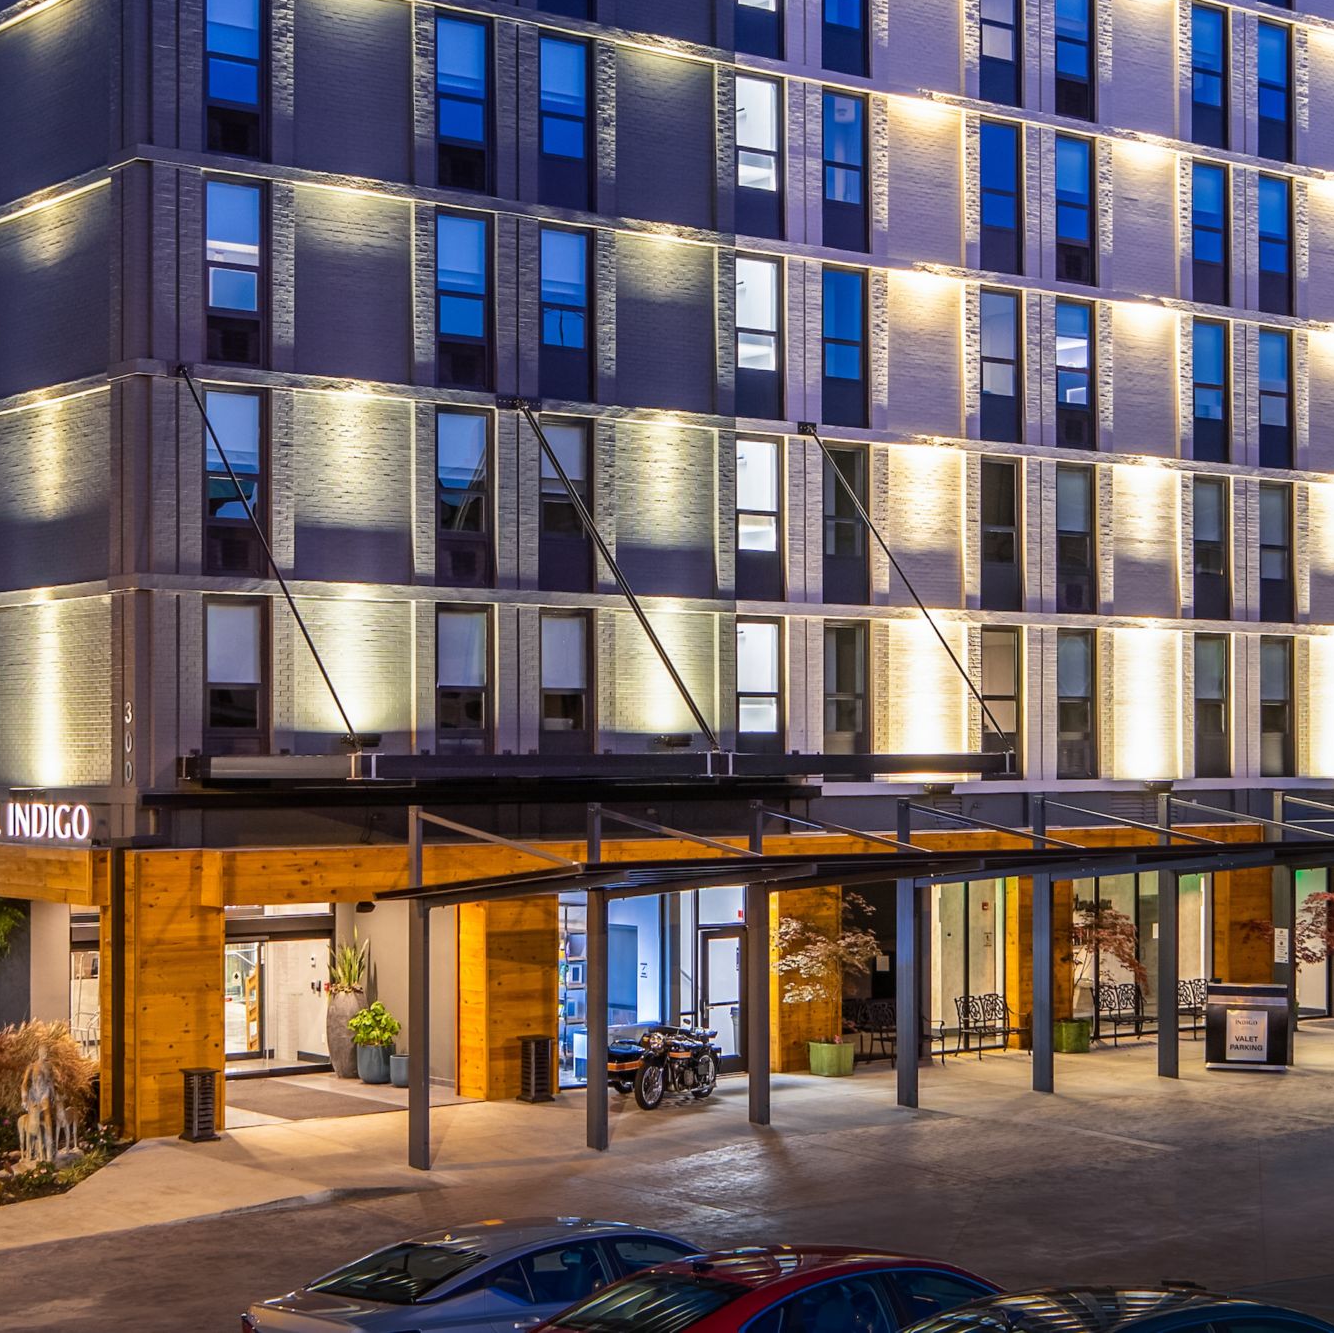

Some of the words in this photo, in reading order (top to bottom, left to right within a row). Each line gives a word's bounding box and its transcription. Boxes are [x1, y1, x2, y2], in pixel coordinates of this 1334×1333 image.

[124, 701, 133, 783] 300
[7, 802, 90, 839] INDIGO
[1229, 1043, 1263, 1052] PARKING
